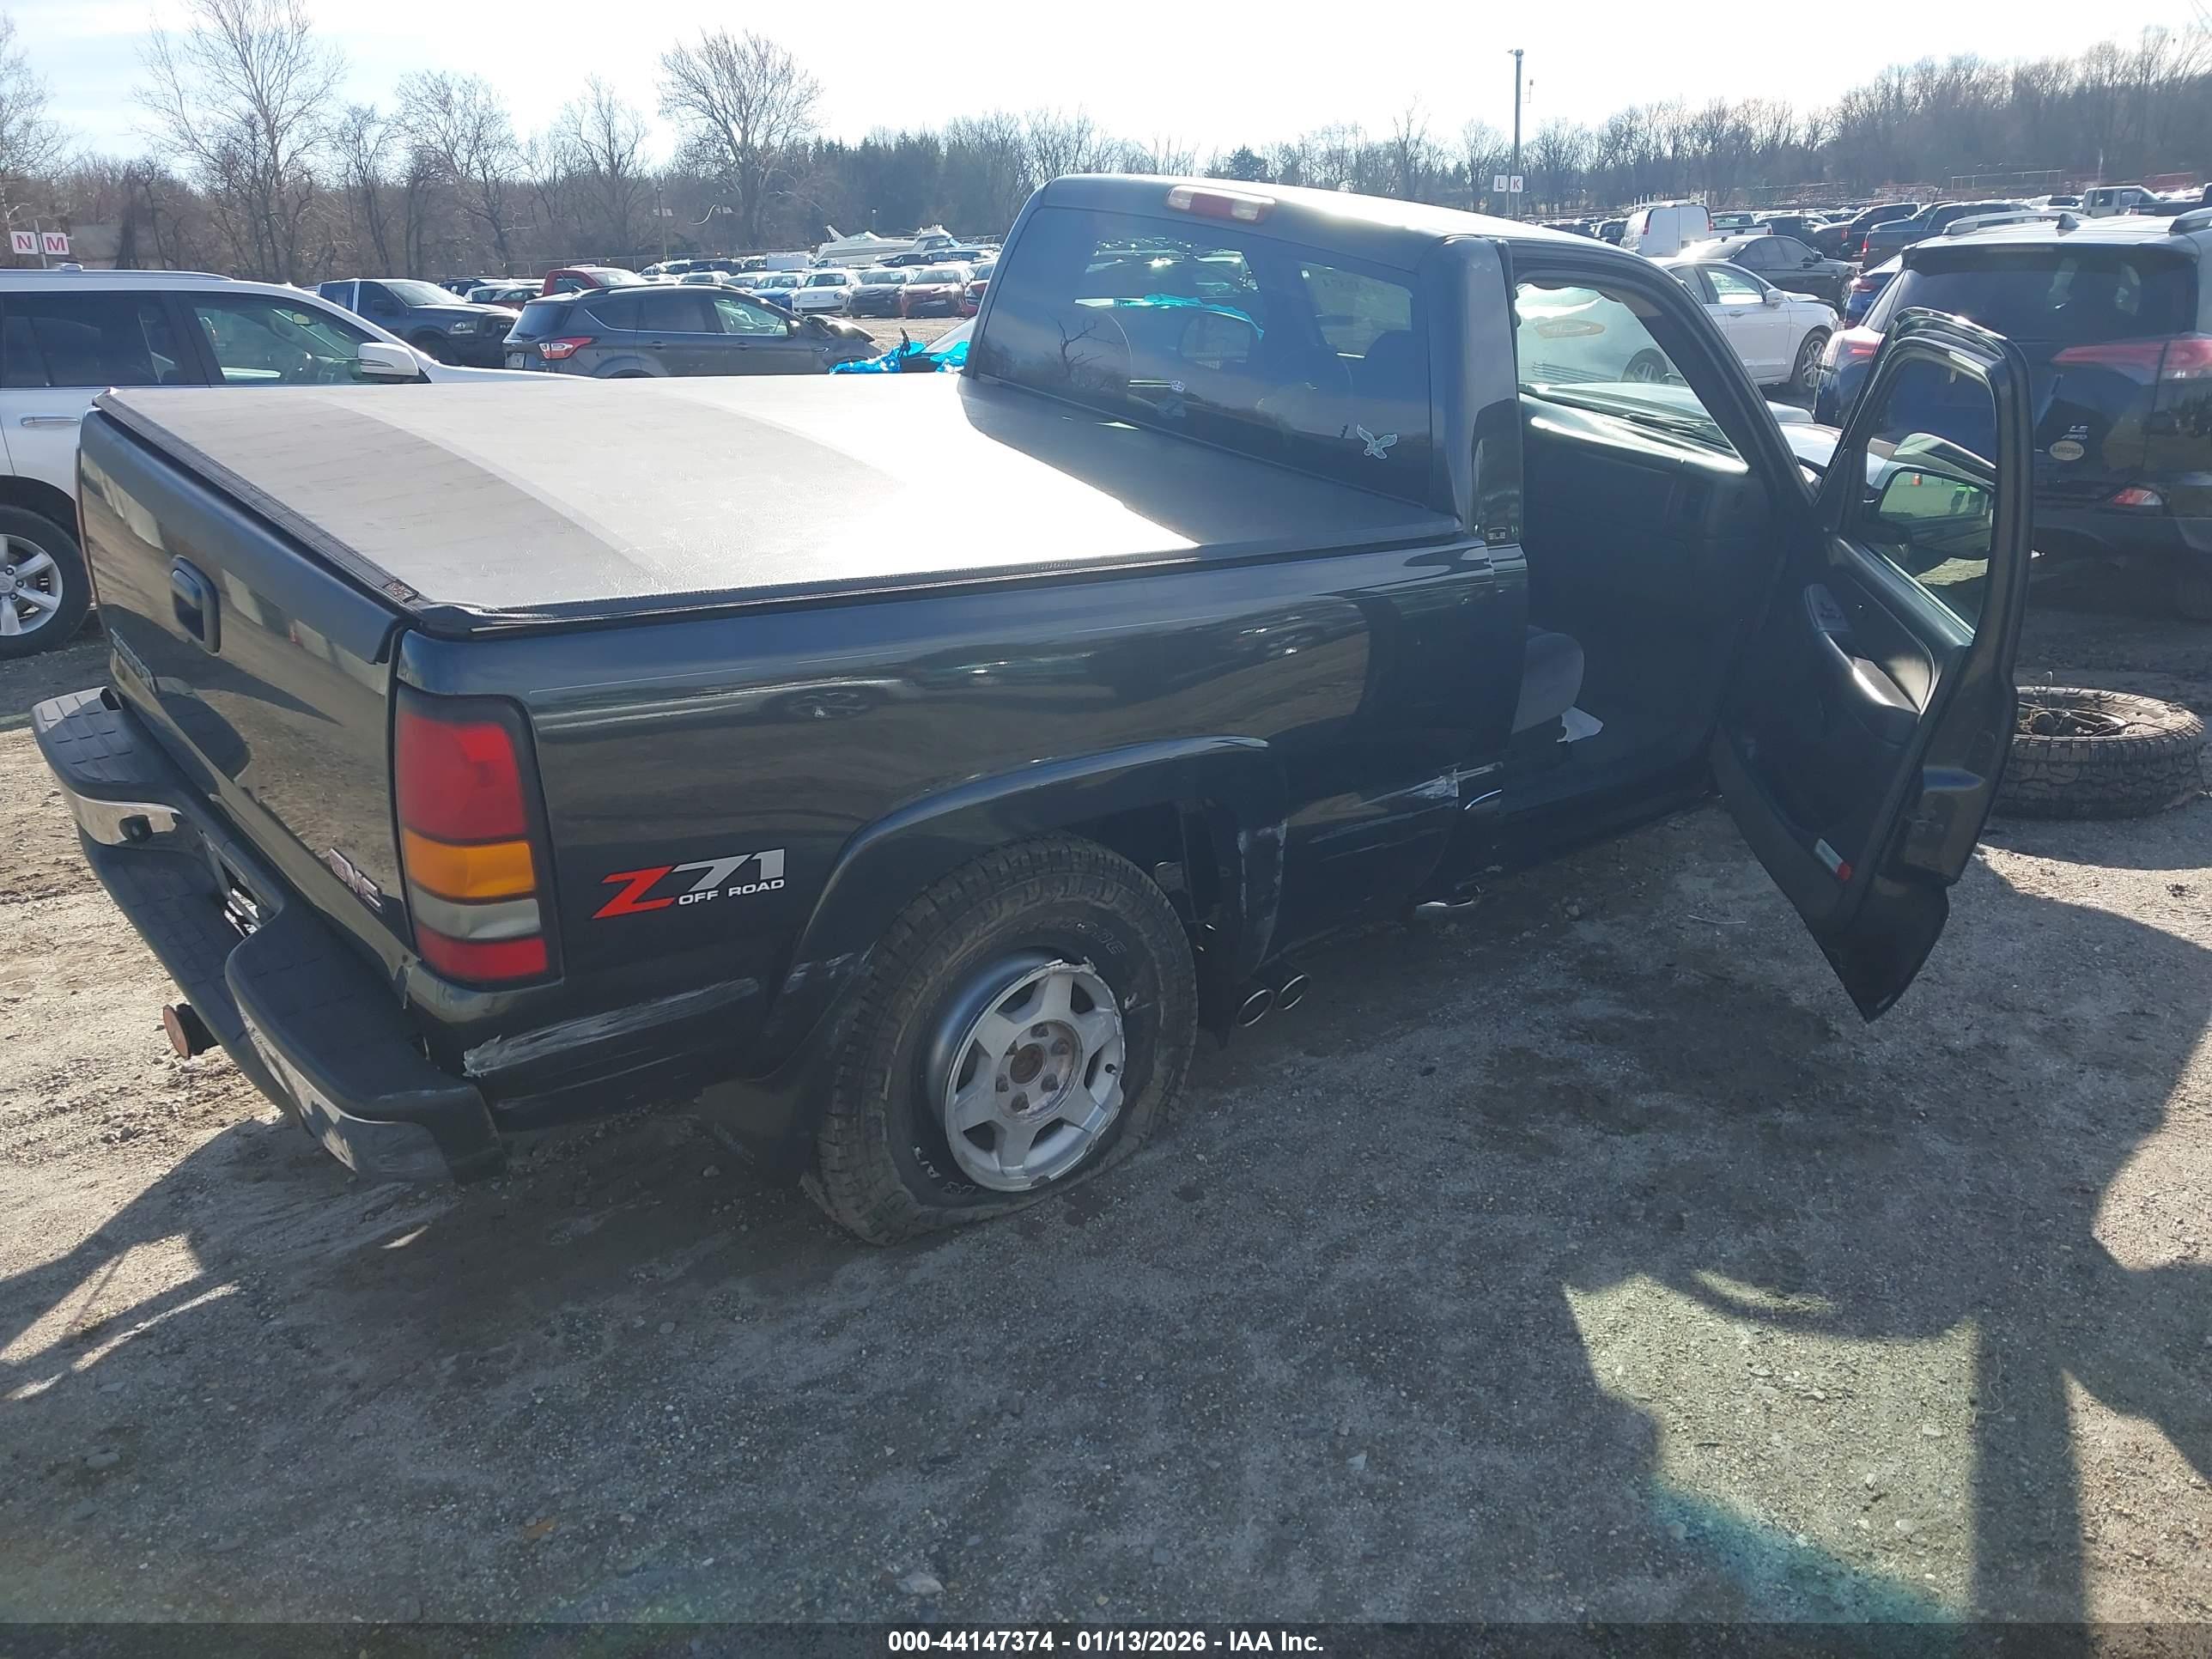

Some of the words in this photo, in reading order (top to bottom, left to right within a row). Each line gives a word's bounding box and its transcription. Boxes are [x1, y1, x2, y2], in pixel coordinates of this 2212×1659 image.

[1497, 178, 1504, 190] L
[1513, 178, 1521, 190] K
[15, 234, 33, 250] N
[46, 236, 66, 252] M
[591, 848, 785, 919] Z71
[678, 890, 720, 905] OFF
[728, 878, 785, 897] ROAD
